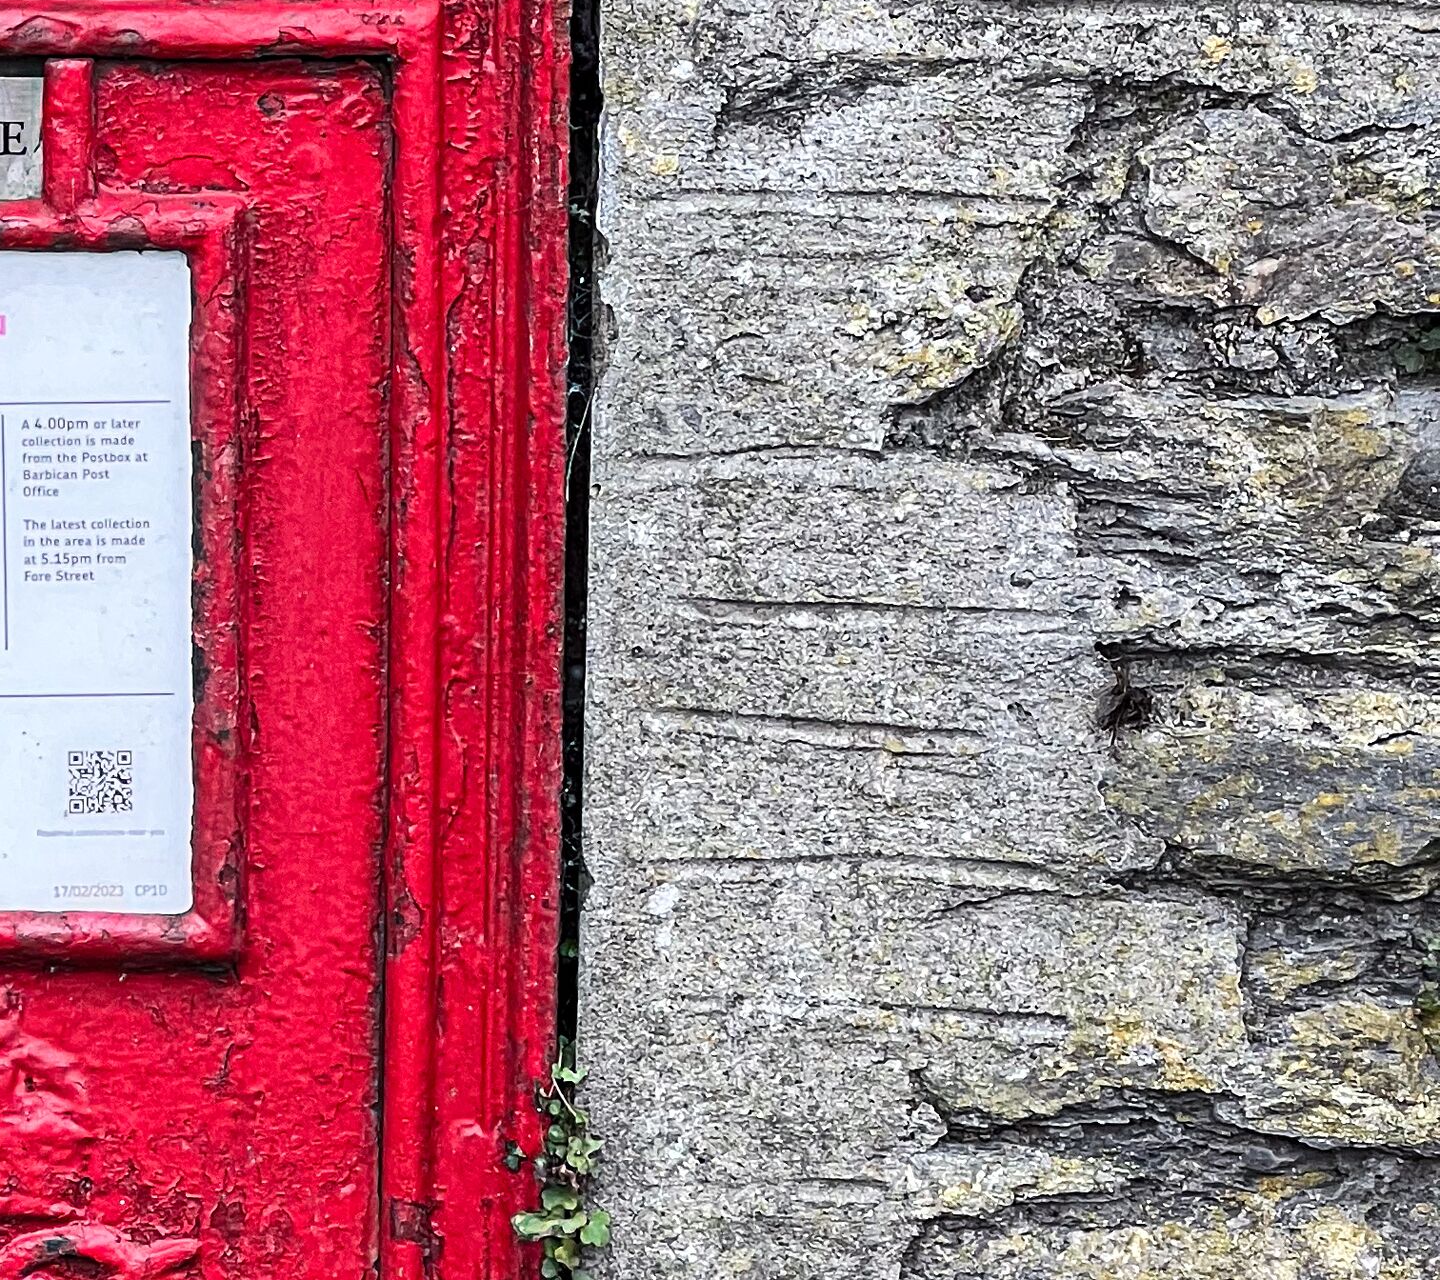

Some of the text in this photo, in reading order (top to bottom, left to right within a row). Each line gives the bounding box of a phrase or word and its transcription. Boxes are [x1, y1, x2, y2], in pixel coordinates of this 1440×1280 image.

[21, 417, 141, 432] A 4.00pm or later
[22, 435, 135, 447] collection is made
[22, 452, 148, 464] from the Postbox at
[23, 468, 110, 480] Barbican Post
[23, 485, 59, 497] Office
[23, 518, 150, 530] The latest collection
[23, 535, 146, 547] in the area is made
[24, 552, 127, 567] at 5.15pm from
[24, 570, 95, 582] Fore Street
[53, 885, 124, 898] 17/02/2023
